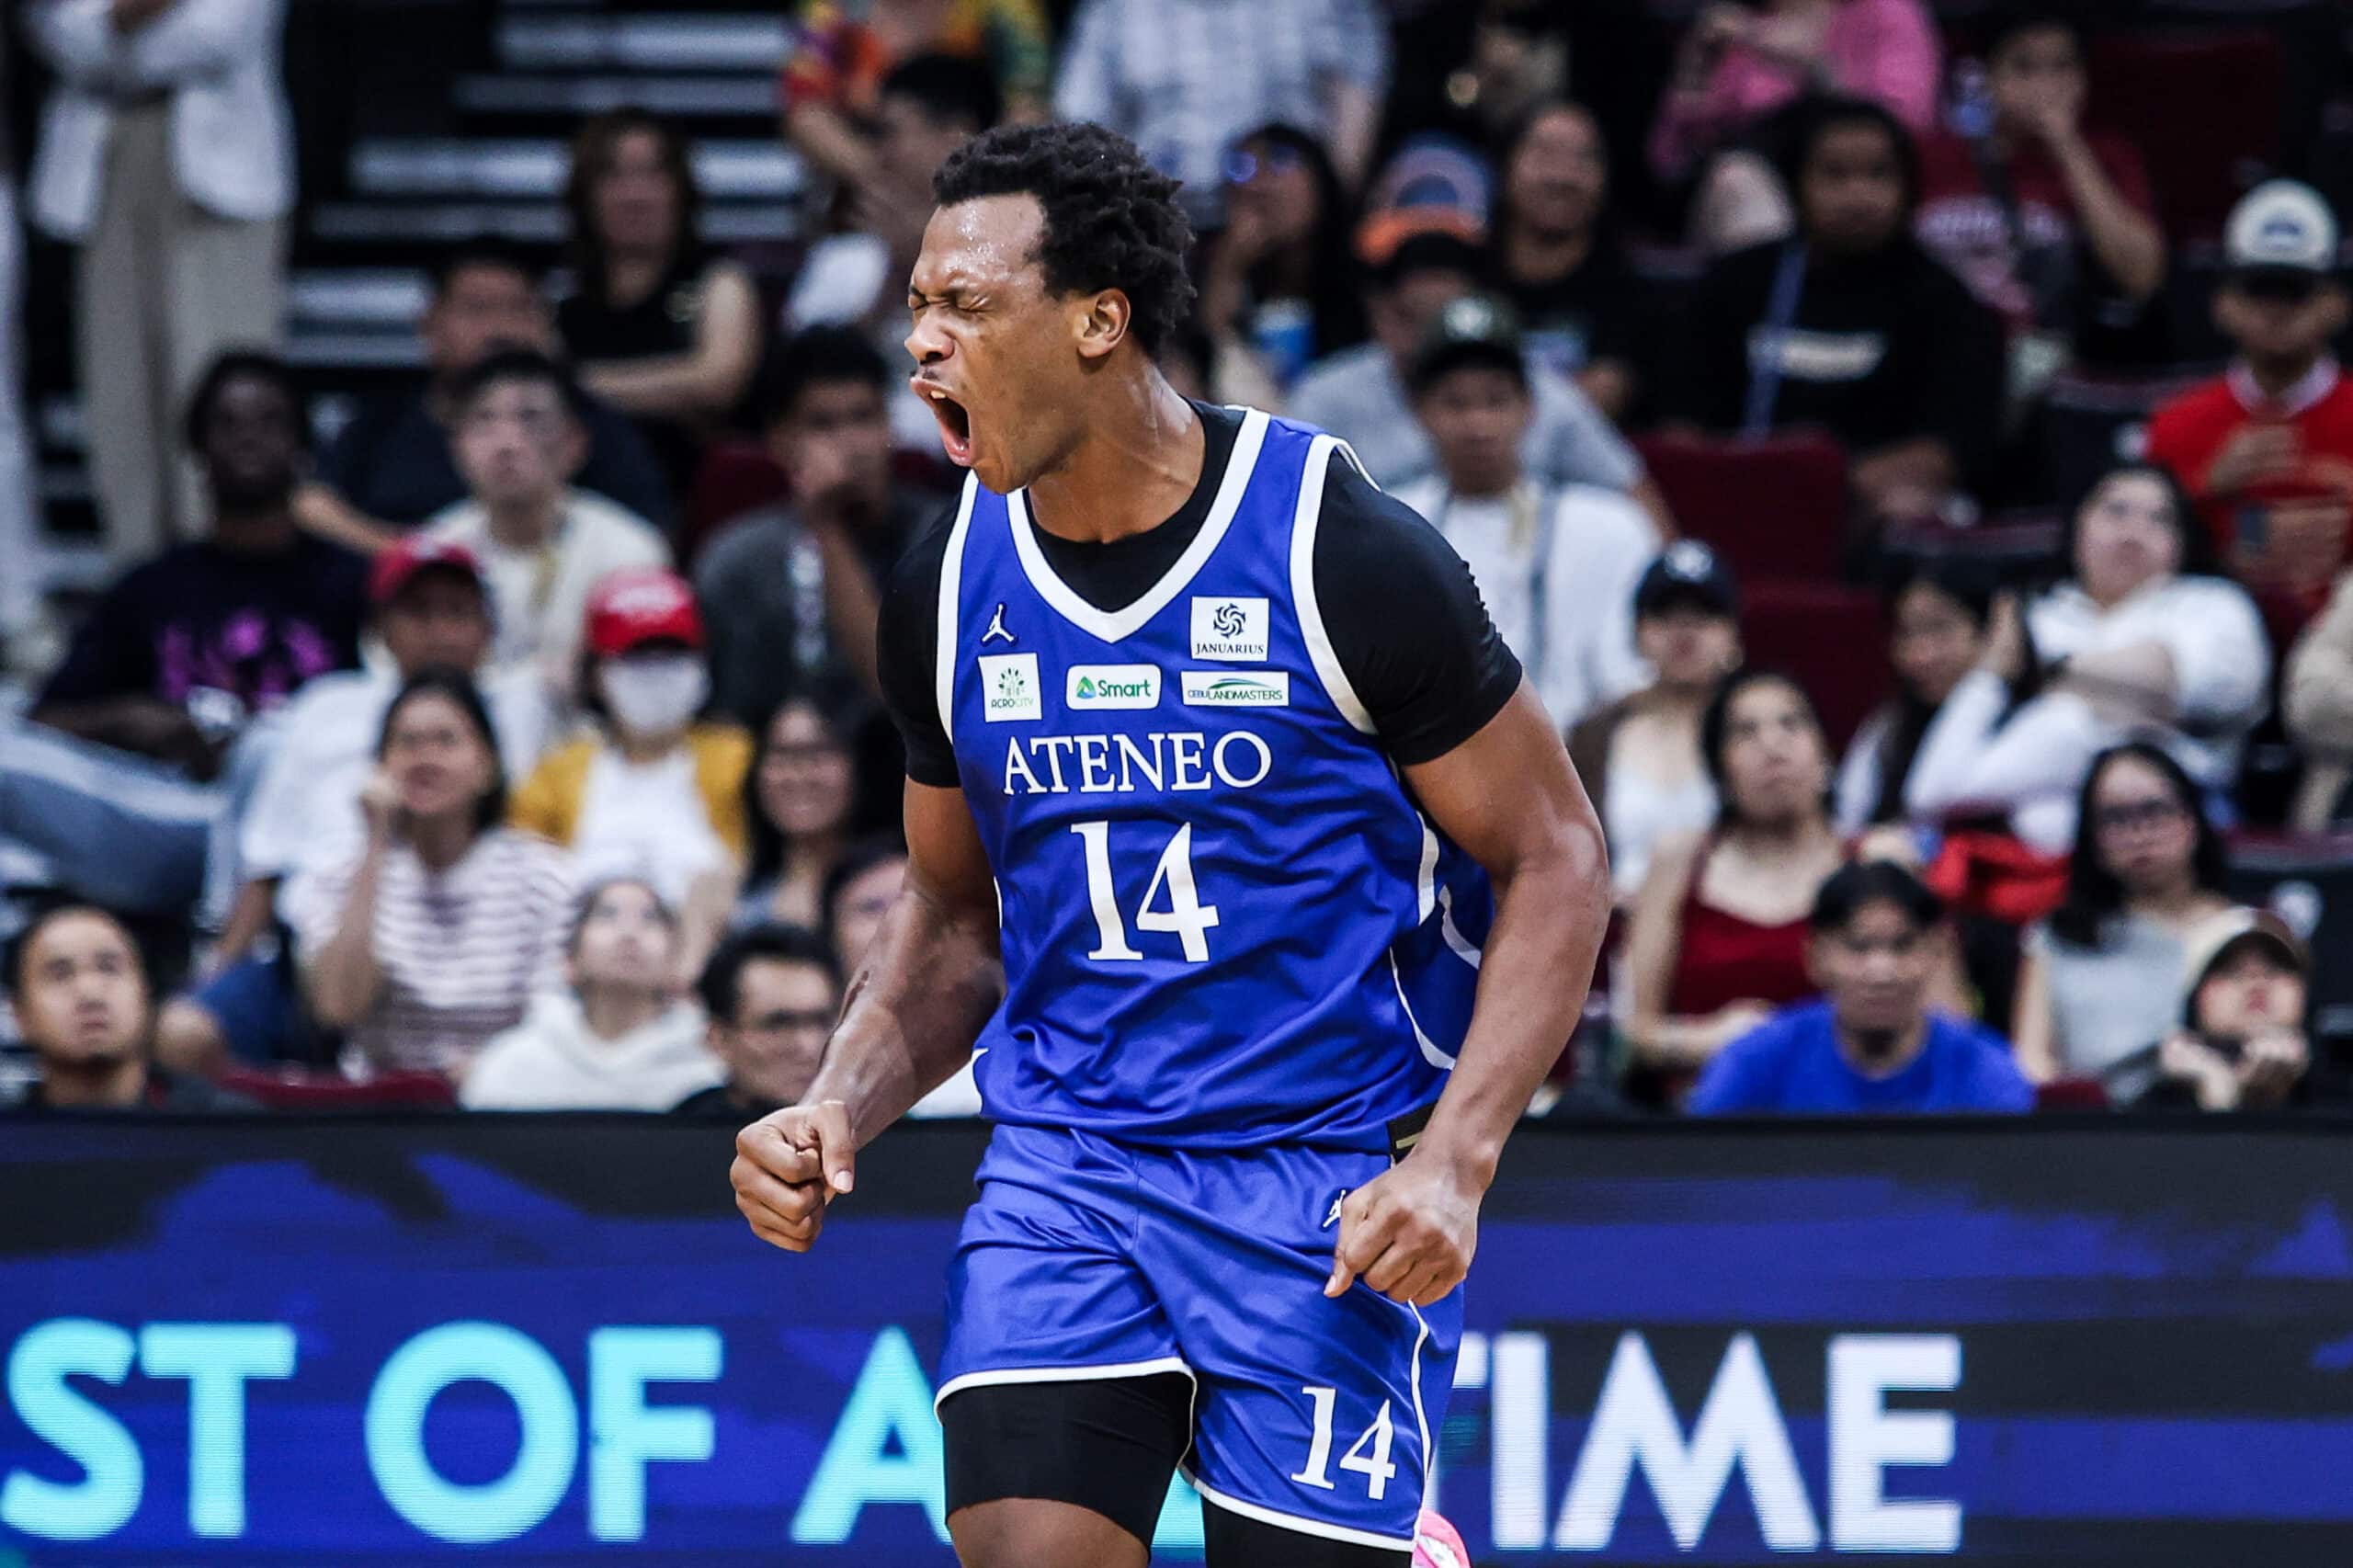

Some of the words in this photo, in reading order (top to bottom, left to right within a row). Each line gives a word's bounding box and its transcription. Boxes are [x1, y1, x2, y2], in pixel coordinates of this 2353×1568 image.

[1097, 678, 1151, 698] Smart
[1196, 642, 1264, 654] JANUARIUS
[1003, 730, 1272, 795] ATENEO
[1070, 820, 1220, 962] 14
[0, 1316, 298, 1541] ST
[365, 1318, 725, 1544] OF
[1290, 1386, 1396, 1500] 14
